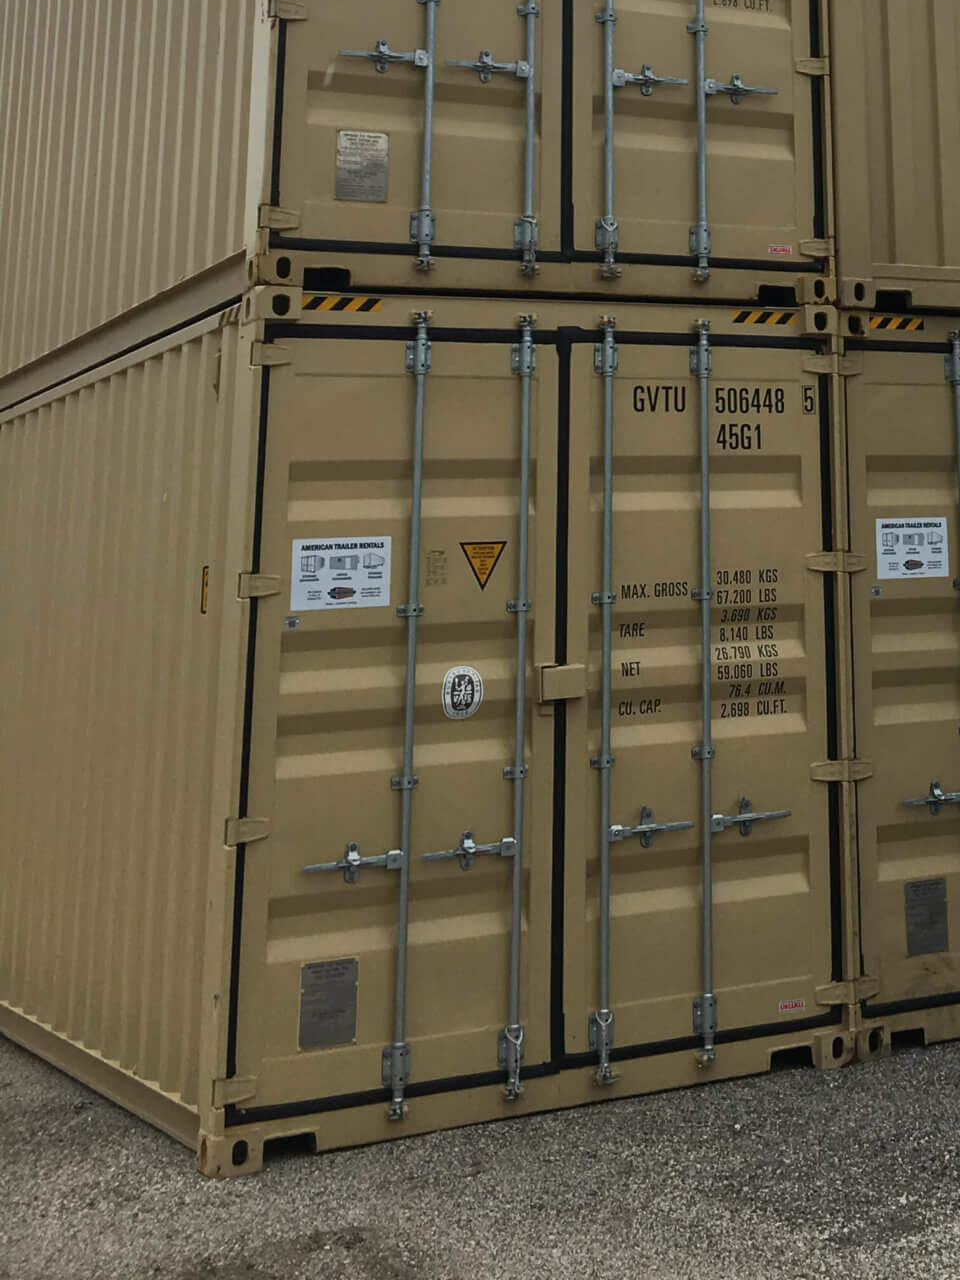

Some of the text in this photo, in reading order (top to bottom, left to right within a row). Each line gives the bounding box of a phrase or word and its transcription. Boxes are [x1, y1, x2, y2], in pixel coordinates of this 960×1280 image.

[633, 385, 814, 414] GVTU 506448 5
[715, 423, 763, 450] 45G1
[301, 541, 385, 552] AMERICAN TRAILER RENTALS
[716, 568, 779, 585] 30.480 KGS
[621, 581, 688, 600] MAX. GROSS
[716, 588, 777, 605] 67.200 LBS
[720, 607, 777, 624] 3.690 KGS
[618, 622, 646, 638] TARE
[719, 624, 774, 642] 8.140 LBS
[715, 644, 779, 661] 26.790 KGS
[620, 661, 641, 677] NET
[717, 662, 779, 680] 59.060 LBS
[728, 684, 751, 698] 76.4
[618, 698, 662, 716] CU. CAP.
[720, 699, 788, 718] 2.698 CU.FT.
